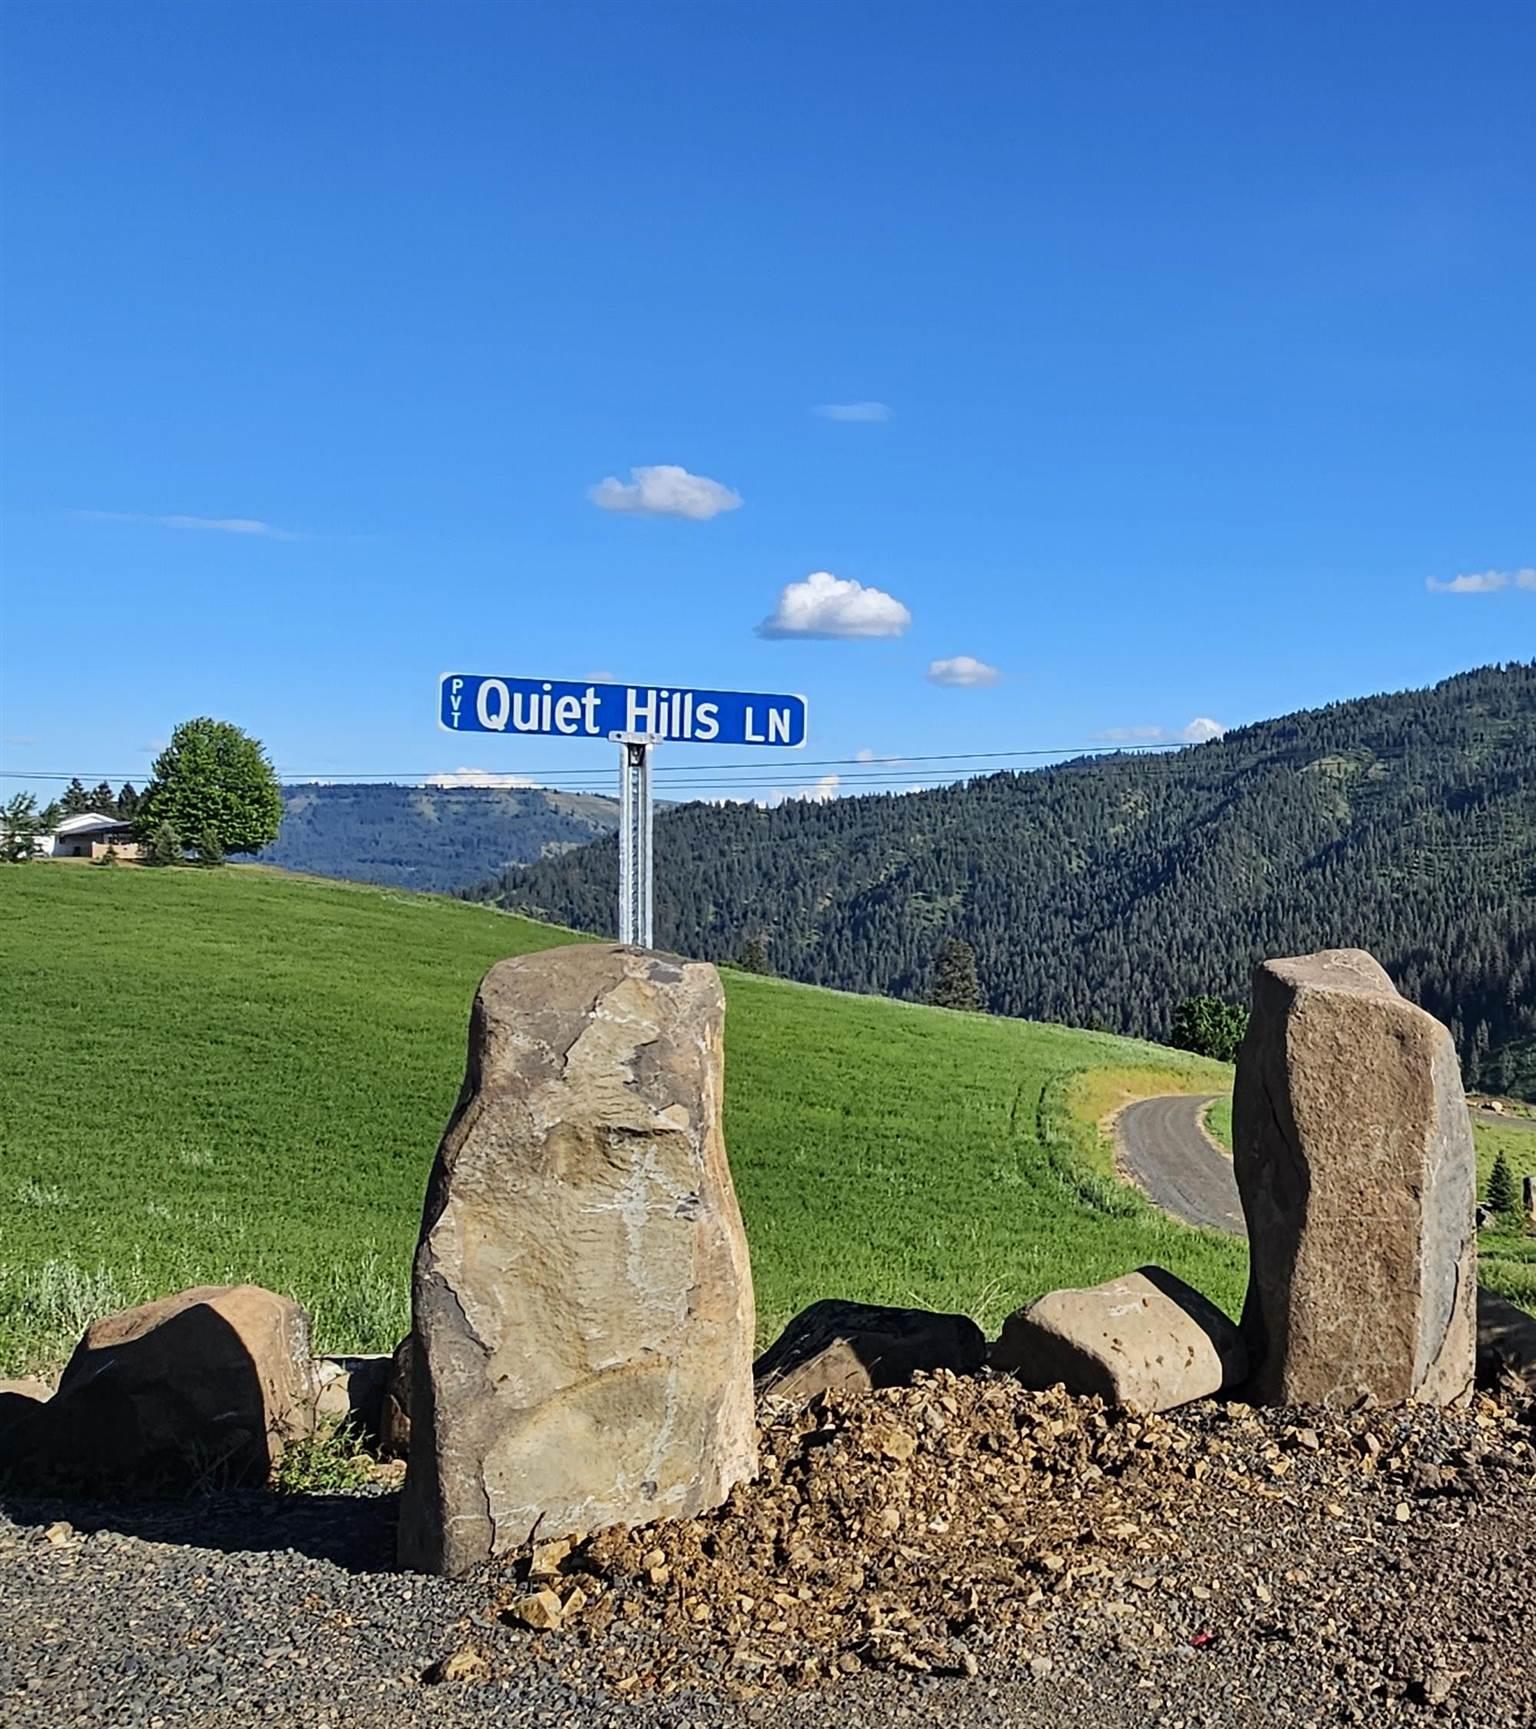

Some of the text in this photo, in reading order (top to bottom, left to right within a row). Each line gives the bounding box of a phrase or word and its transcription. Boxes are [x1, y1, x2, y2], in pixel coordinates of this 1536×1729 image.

[451, 679, 464, 728] PVT
[476, 679, 791, 744] Quiet Hills LN
